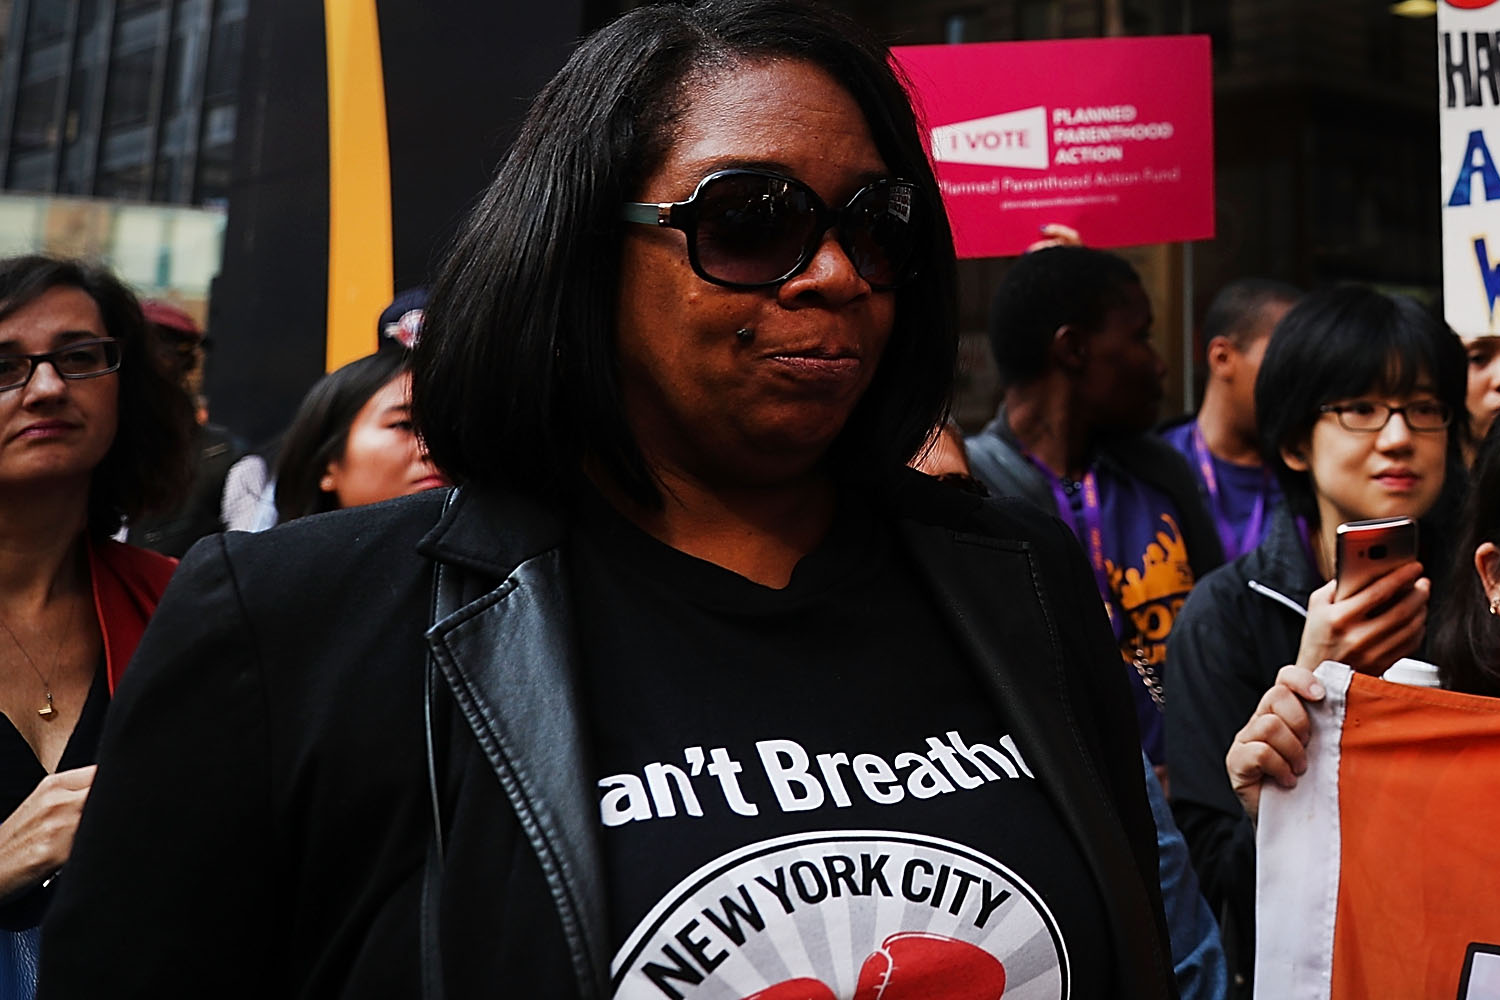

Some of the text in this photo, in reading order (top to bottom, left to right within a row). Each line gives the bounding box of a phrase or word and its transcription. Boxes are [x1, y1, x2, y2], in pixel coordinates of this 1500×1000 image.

[1052, 104, 1137, 125] PLANNED
[963, 128, 1030, 150] VOTE
[1053, 122, 1174, 145] PARENTHOOD
[1054, 145, 1123, 165] ACTION
[938, 178, 1000, 196] lanned
[597, 730, 1036, 827] an't Breath
[641, 852, 1012, 1000] NEW YORK CITY
